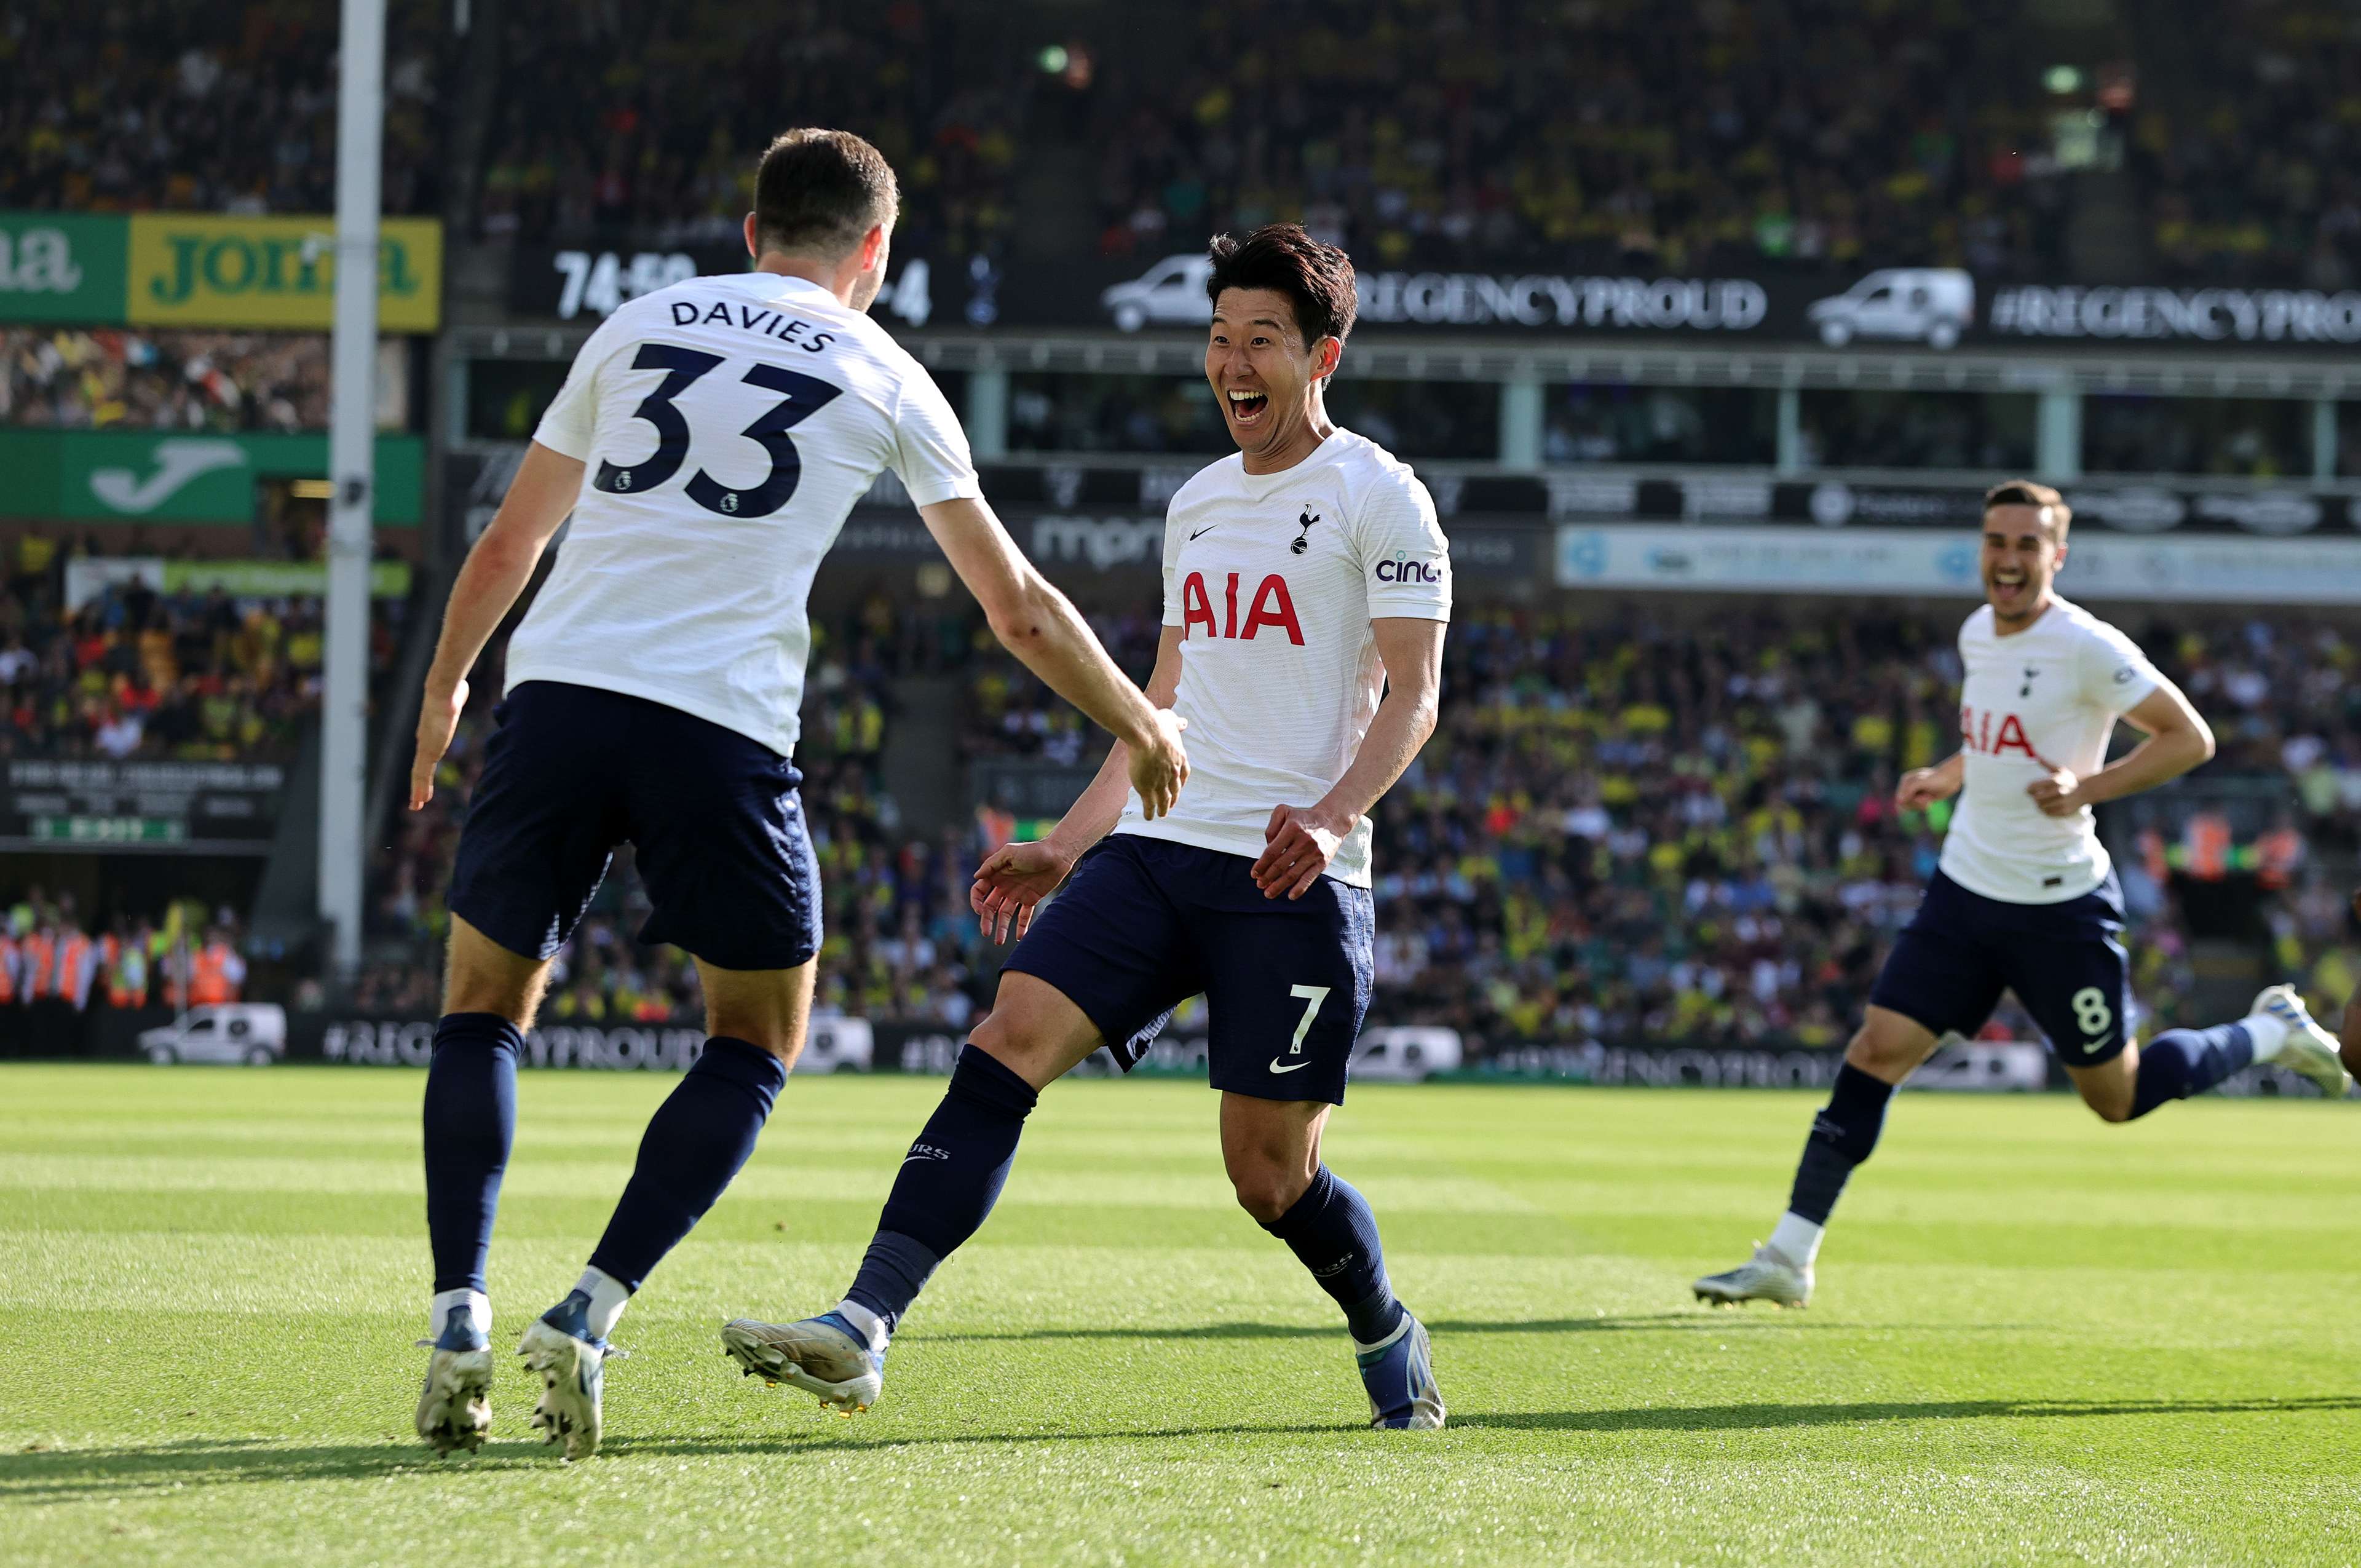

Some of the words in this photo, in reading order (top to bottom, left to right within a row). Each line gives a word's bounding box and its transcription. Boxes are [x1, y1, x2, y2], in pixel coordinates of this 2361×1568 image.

[0, 228, 82, 294] a
[671, 301, 836, 354] DAVIES
[593, 343, 844, 518] 33
[1183, 572, 1305, 646] AIA
[1289, 984, 1330, 1054] 7
[2071, 987, 2111, 1034] 8
